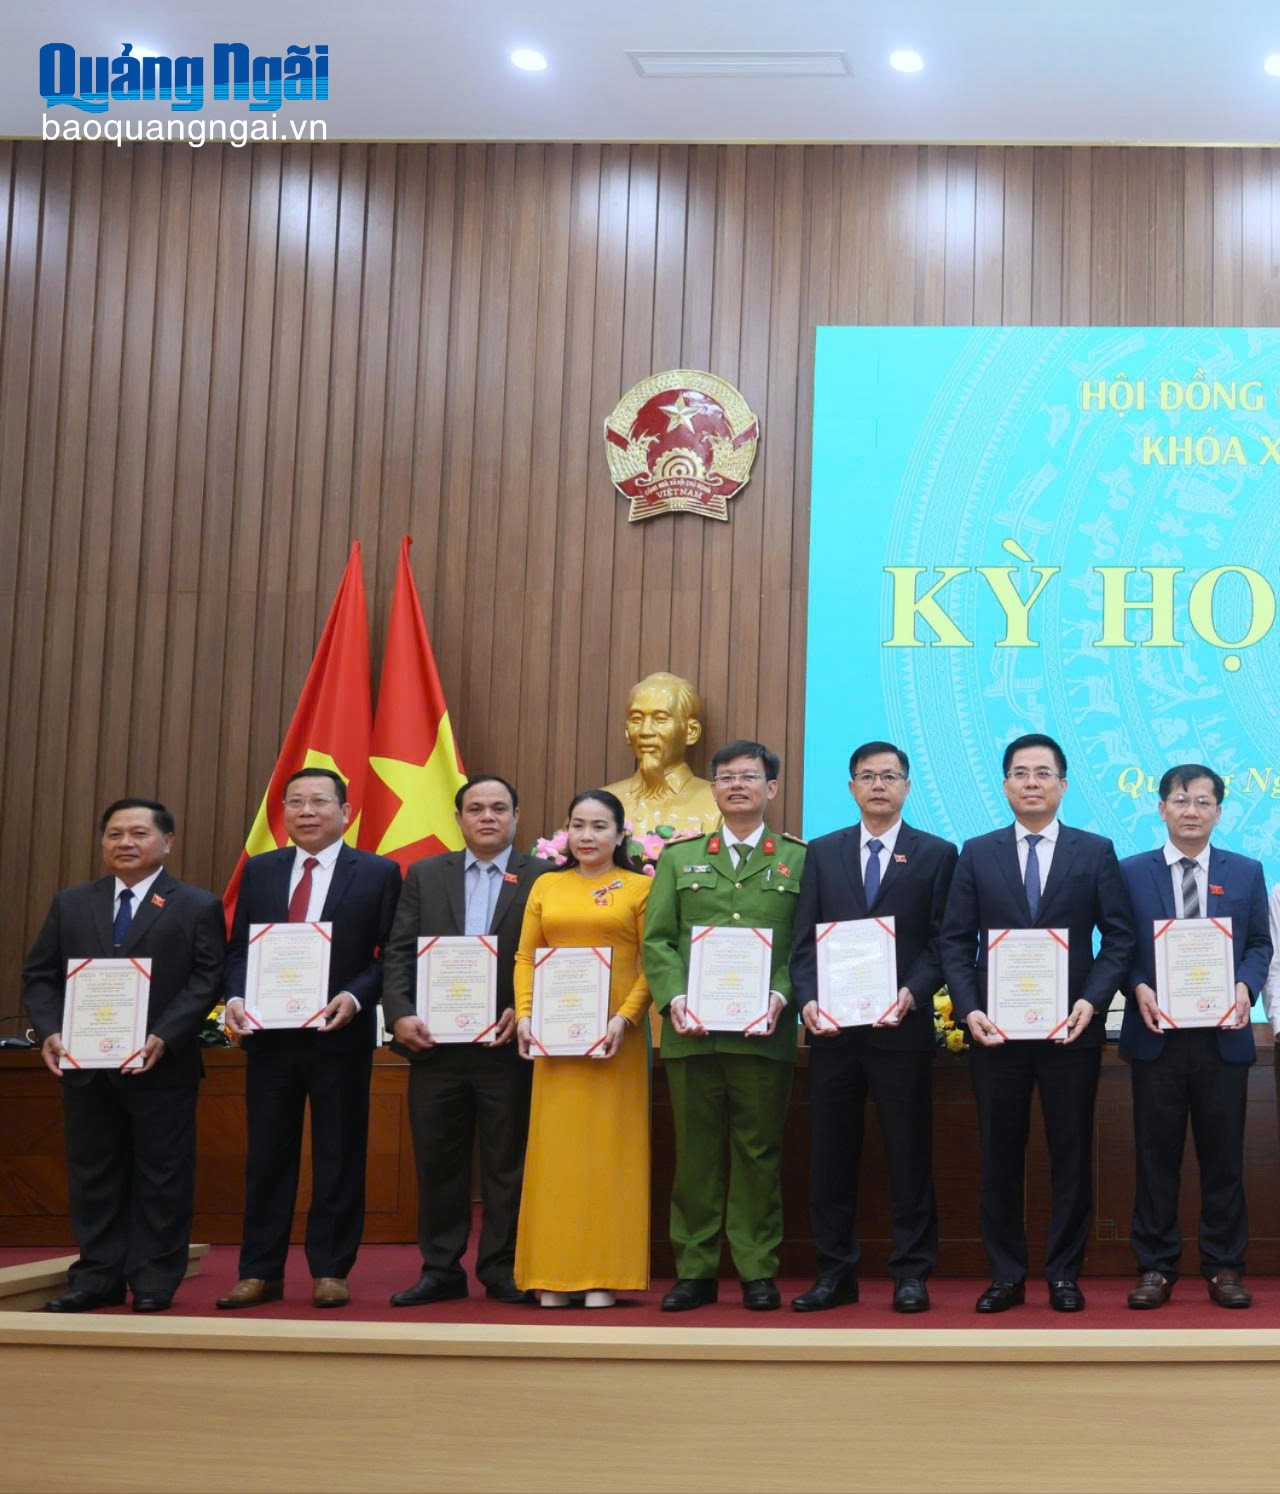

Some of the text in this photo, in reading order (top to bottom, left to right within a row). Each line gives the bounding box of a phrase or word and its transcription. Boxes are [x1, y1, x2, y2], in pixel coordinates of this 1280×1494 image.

[1081, 371, 1146, 418] HỘI
[1158, 367, 1265, 412] ĐỒNG
[1141, 426, 1248, 466] KHÓA
[881, 537, 1062, 649] KỲ
